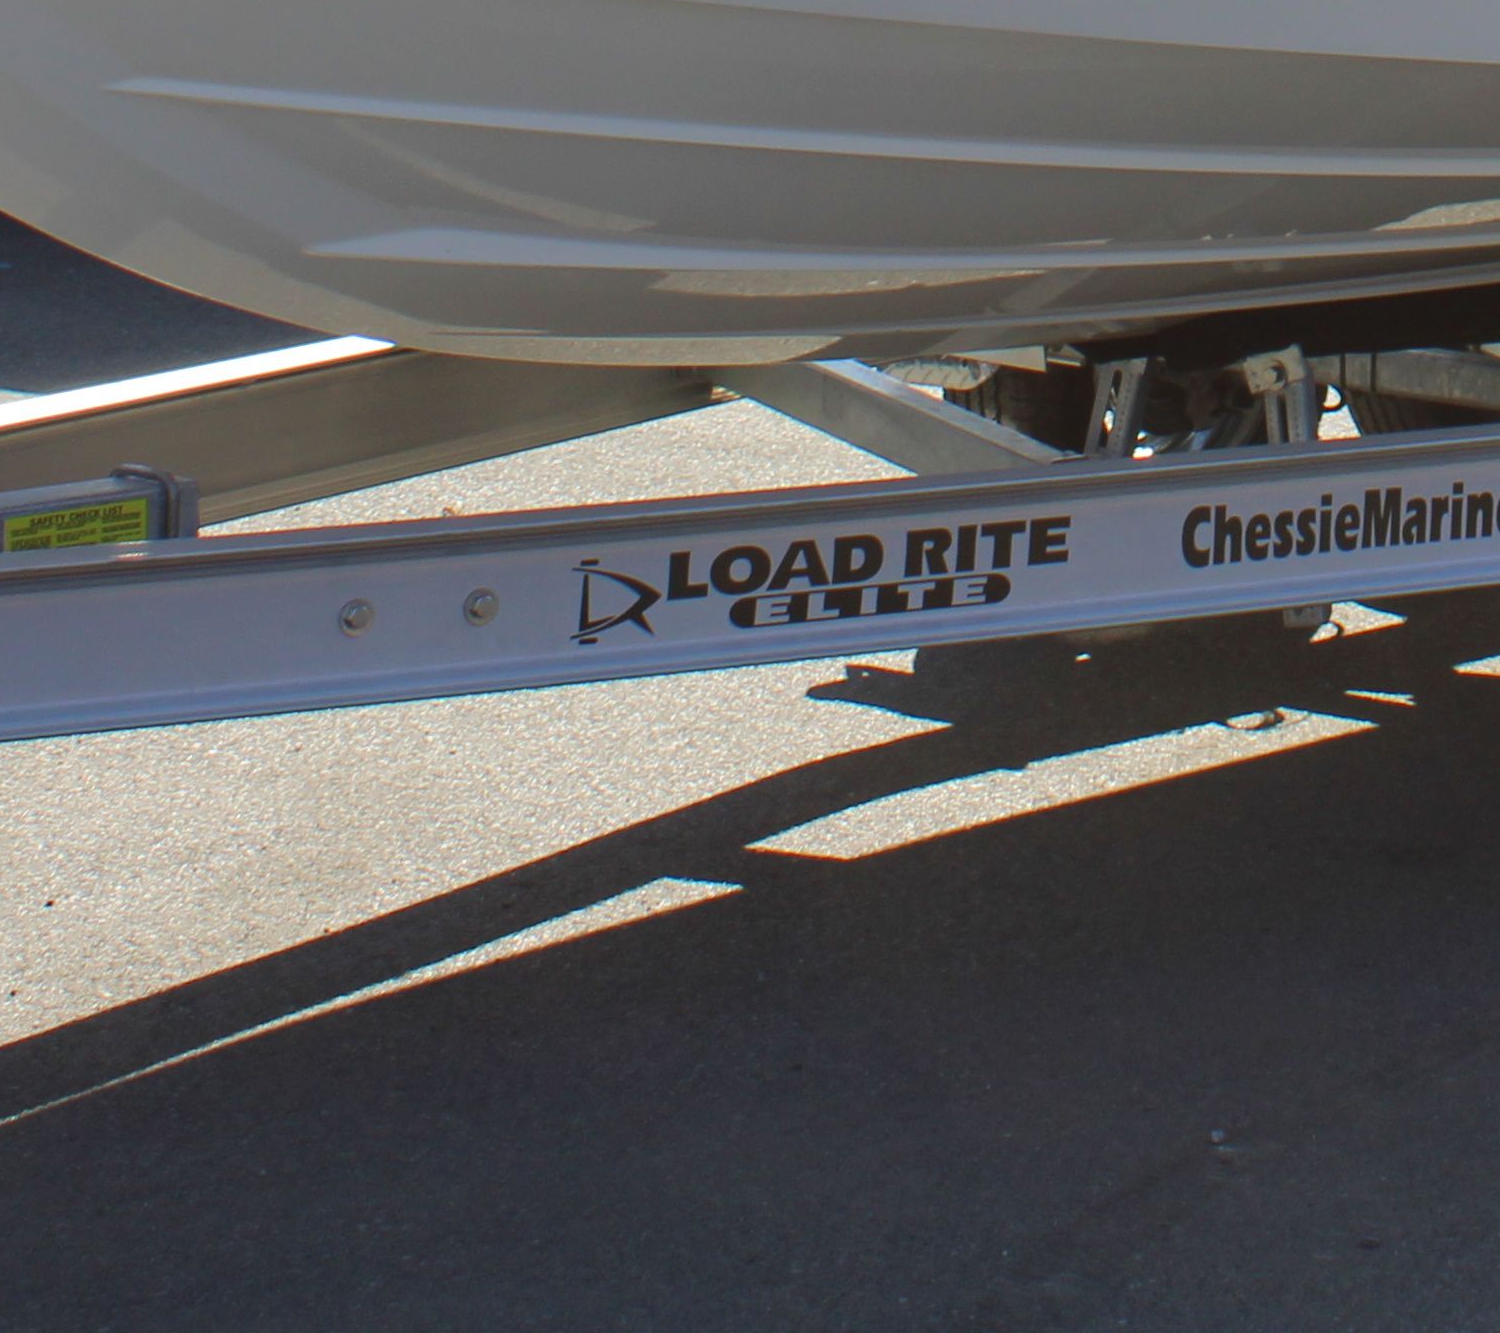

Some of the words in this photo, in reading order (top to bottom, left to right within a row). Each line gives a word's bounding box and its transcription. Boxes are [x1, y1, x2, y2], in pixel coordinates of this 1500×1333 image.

[30, 513, 67, 527] SAFETY
[68, 508, 101, 521] CHECK
[101, 504, 125, 517] LIST
[668, 532, 886, 601] LOAD
[903, 514, 1073, 578] RITE
[752, 576, 989, 627] ELITE
